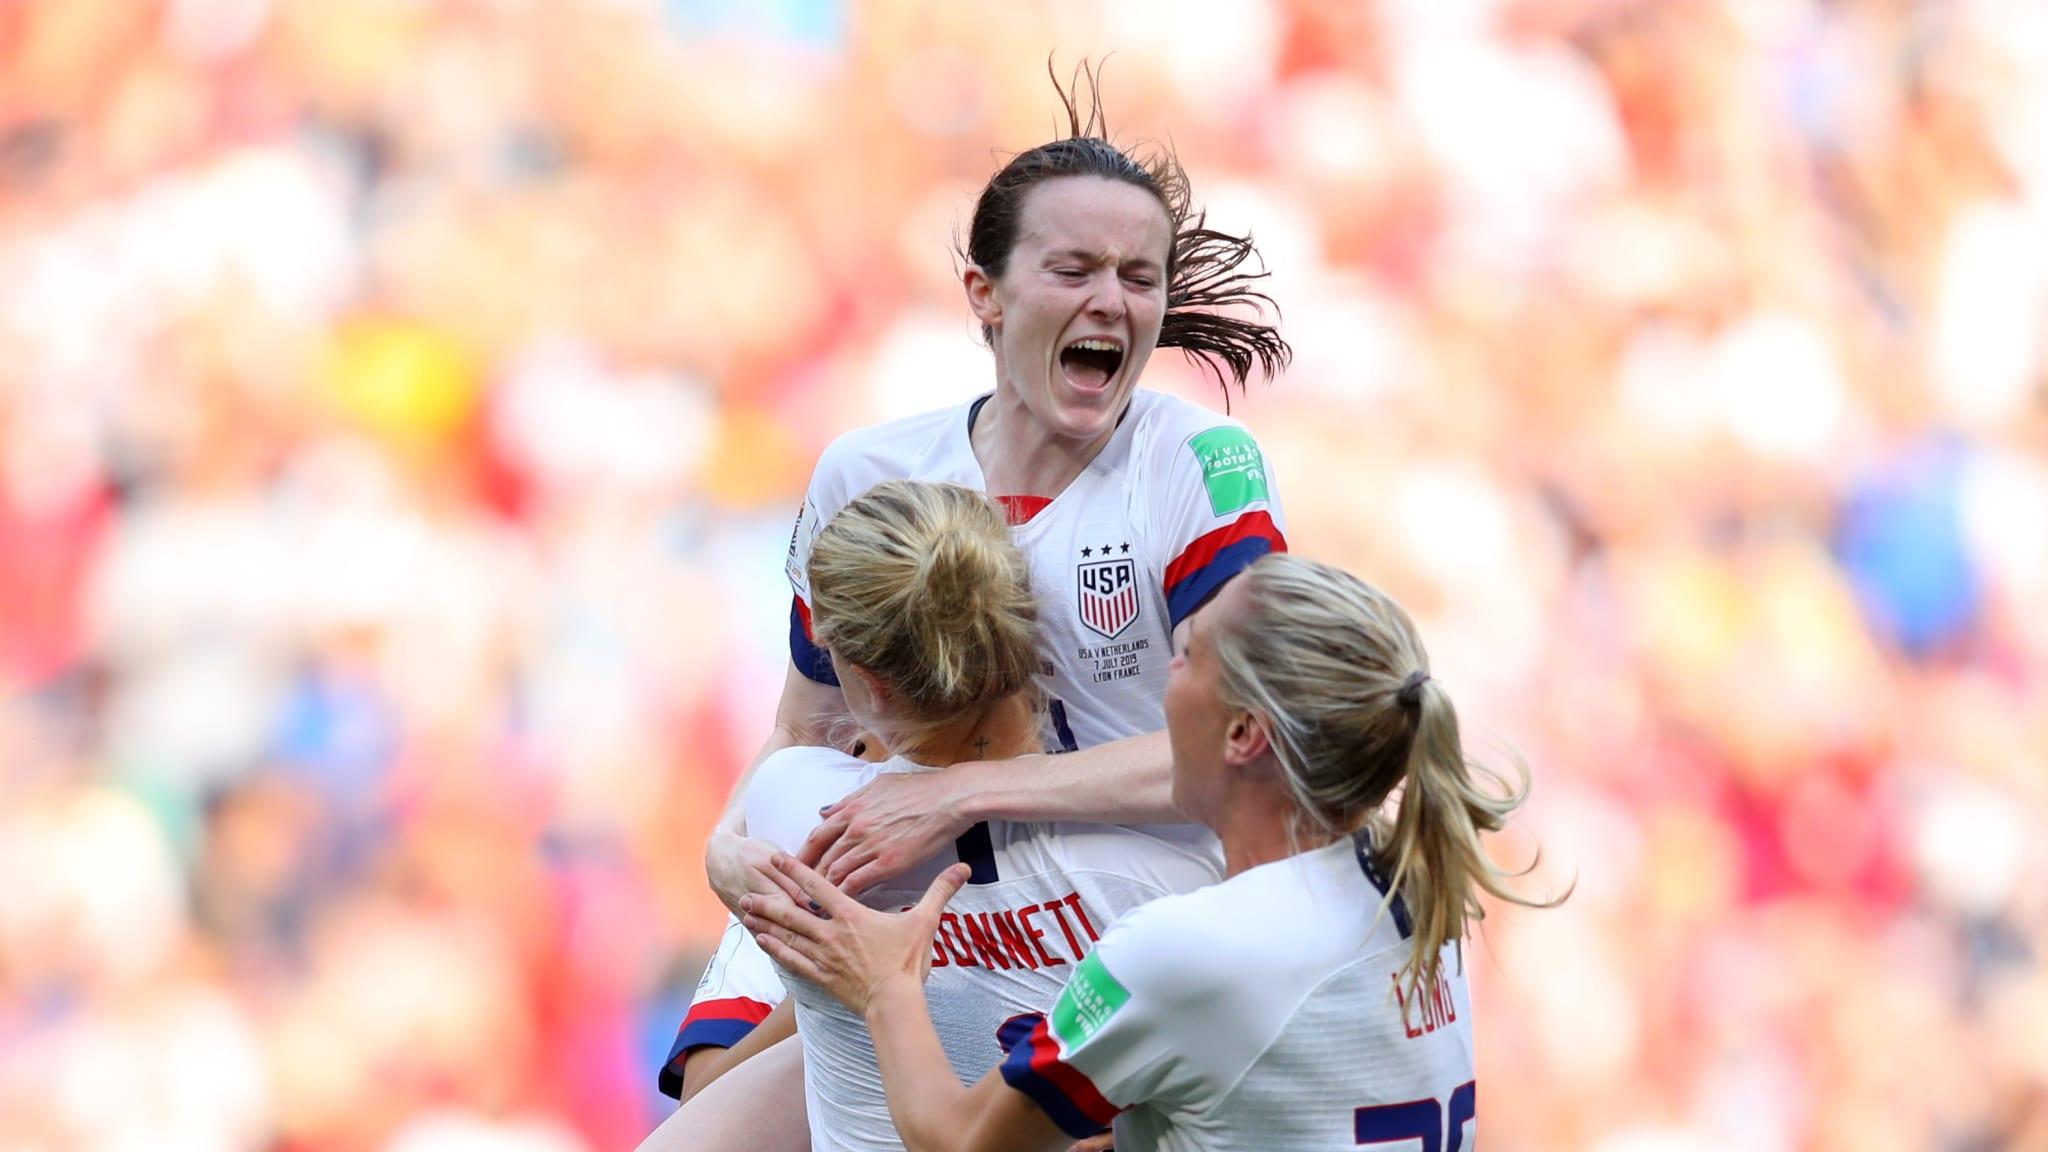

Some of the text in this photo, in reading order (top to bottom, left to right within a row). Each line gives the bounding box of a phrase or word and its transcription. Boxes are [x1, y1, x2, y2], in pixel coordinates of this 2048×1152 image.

[1208, 455, 1257, 471] FOOTBA
[1083, 565, 1130, 595] USA
[1078, 639, 1149, 659] USA V NETHERLANDS
[1094, 653, 1137, 670] 7 JULY 2019
[1093, 665, 1140, 682] LYON FRANCE
